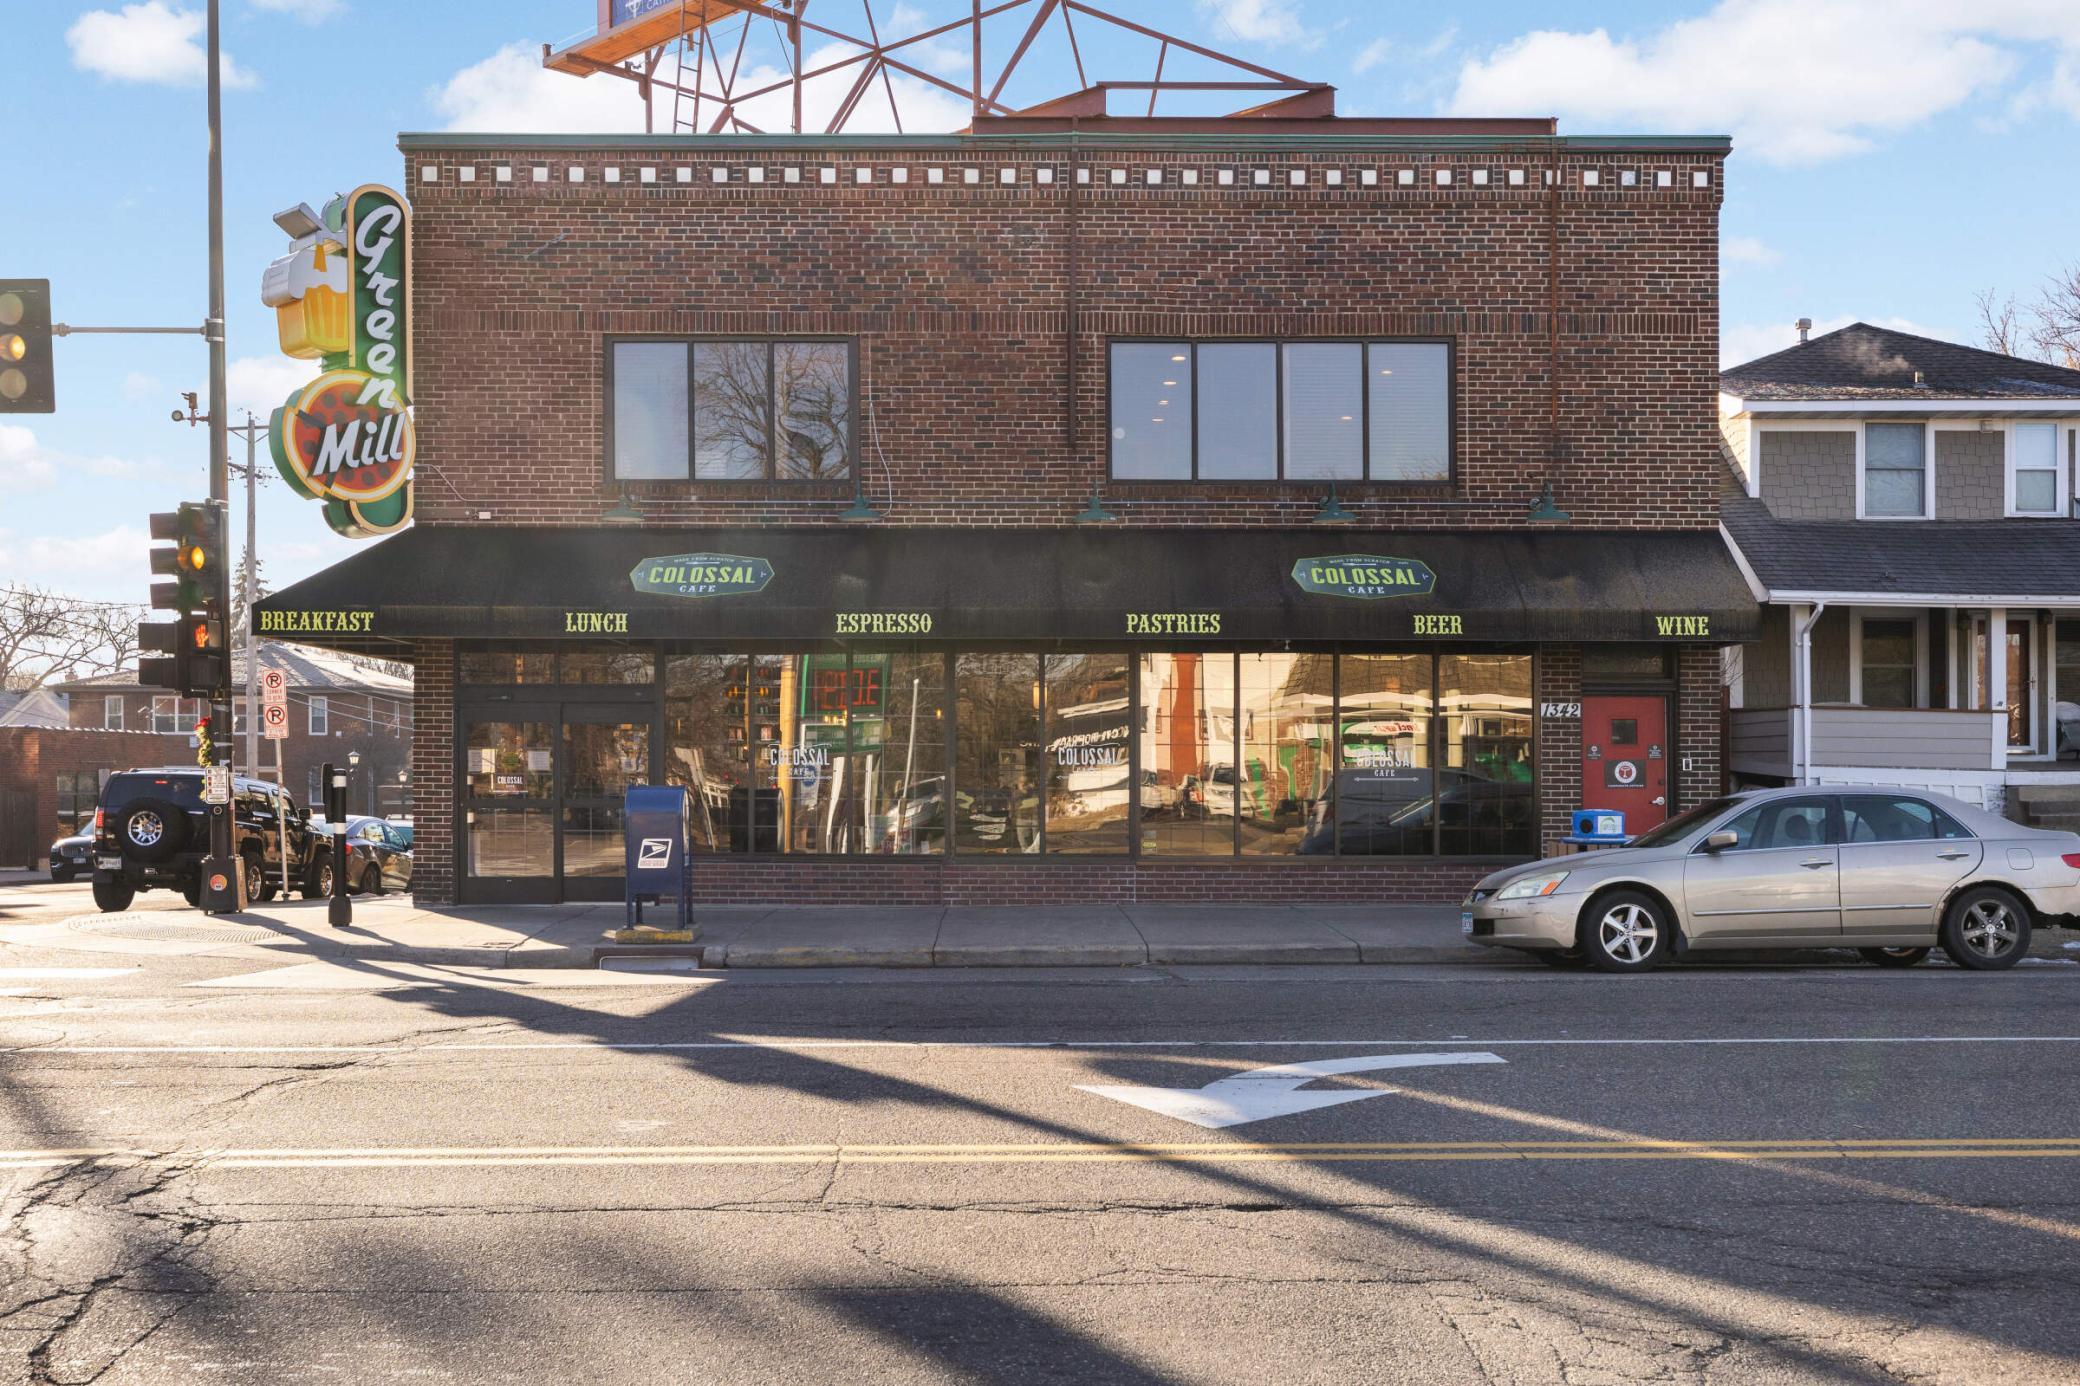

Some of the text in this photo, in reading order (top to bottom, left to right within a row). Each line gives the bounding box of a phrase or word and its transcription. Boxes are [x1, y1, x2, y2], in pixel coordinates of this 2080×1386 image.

[355, 204, 402, 409] Green
[312, 412, 407, 477] Mill
[648, 566, 756, 584] COLOSSAL
[1310, 567, 1421, 586] COLOSSAL
[679, 585, 716, 593] CAFE
[1348, 586, 1385, 594] CAFE
[260, 611, 375, 631] BREAKFAST
[565, 612, 629, 633] LUNCH
[836, 613, 932, 633] ESPRESSO
[1126, 613, 1221, 634] PASTRIES
[1413, 614, 1464, 635] BEER
[1655, 615, 1710, 636] WINE
[1544, 703, 1579, 717] 1342
[770, 748, 830, 765] COLOSSAL
[497, 776, 523, 784] COLOSSAL
[1374, 769, 1395, 777] CAFE
